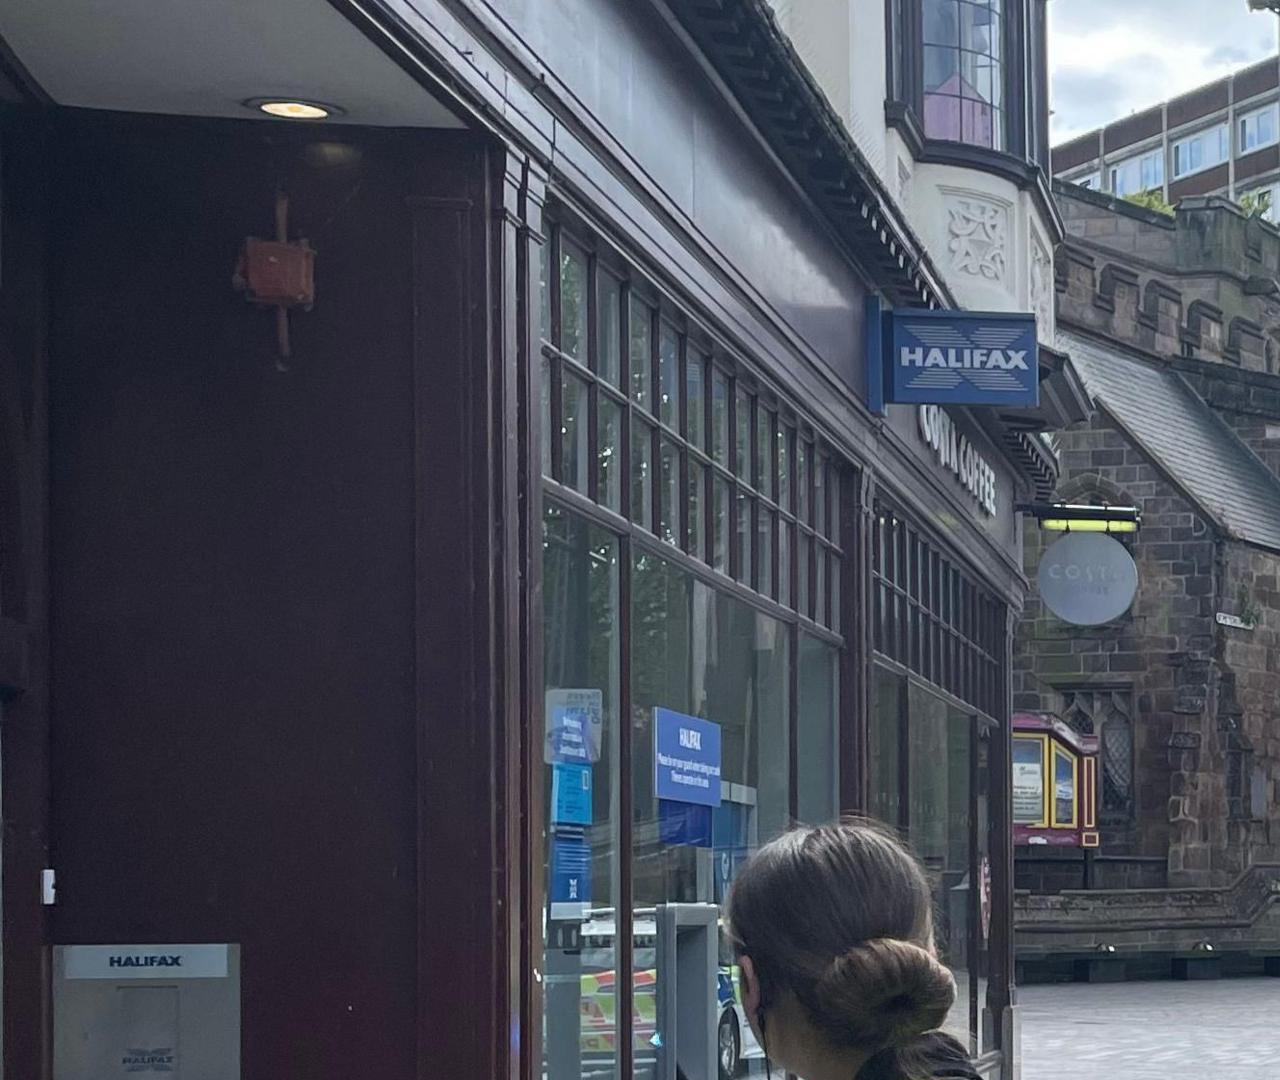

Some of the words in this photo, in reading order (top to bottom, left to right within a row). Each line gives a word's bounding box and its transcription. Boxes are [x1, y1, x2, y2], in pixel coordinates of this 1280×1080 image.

[901, 347, 1029, 370] HALIFAX
[959, 434, 997, 517] COFFEE
[109, 955, 182, 967] HALIFAX
[122, 1055, 174, 1065] HALIFAX
